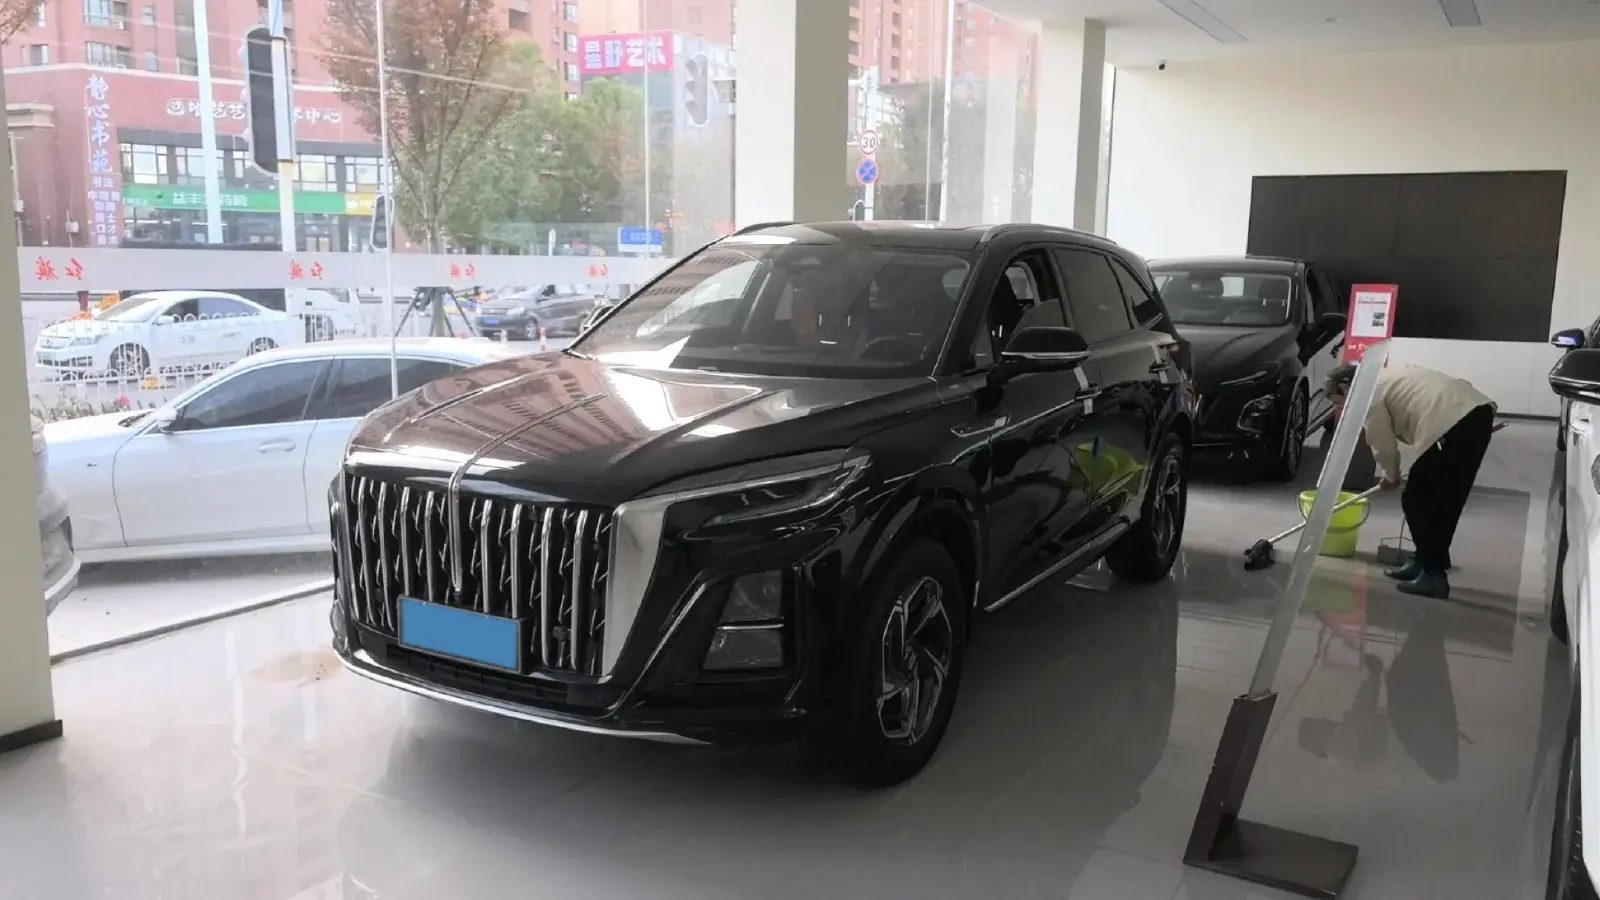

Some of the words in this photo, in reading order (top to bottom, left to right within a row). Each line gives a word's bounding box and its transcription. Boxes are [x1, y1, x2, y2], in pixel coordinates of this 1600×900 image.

[862, 136, 876, 149] 30
[172, 192, 248, 206] 益丰药房
